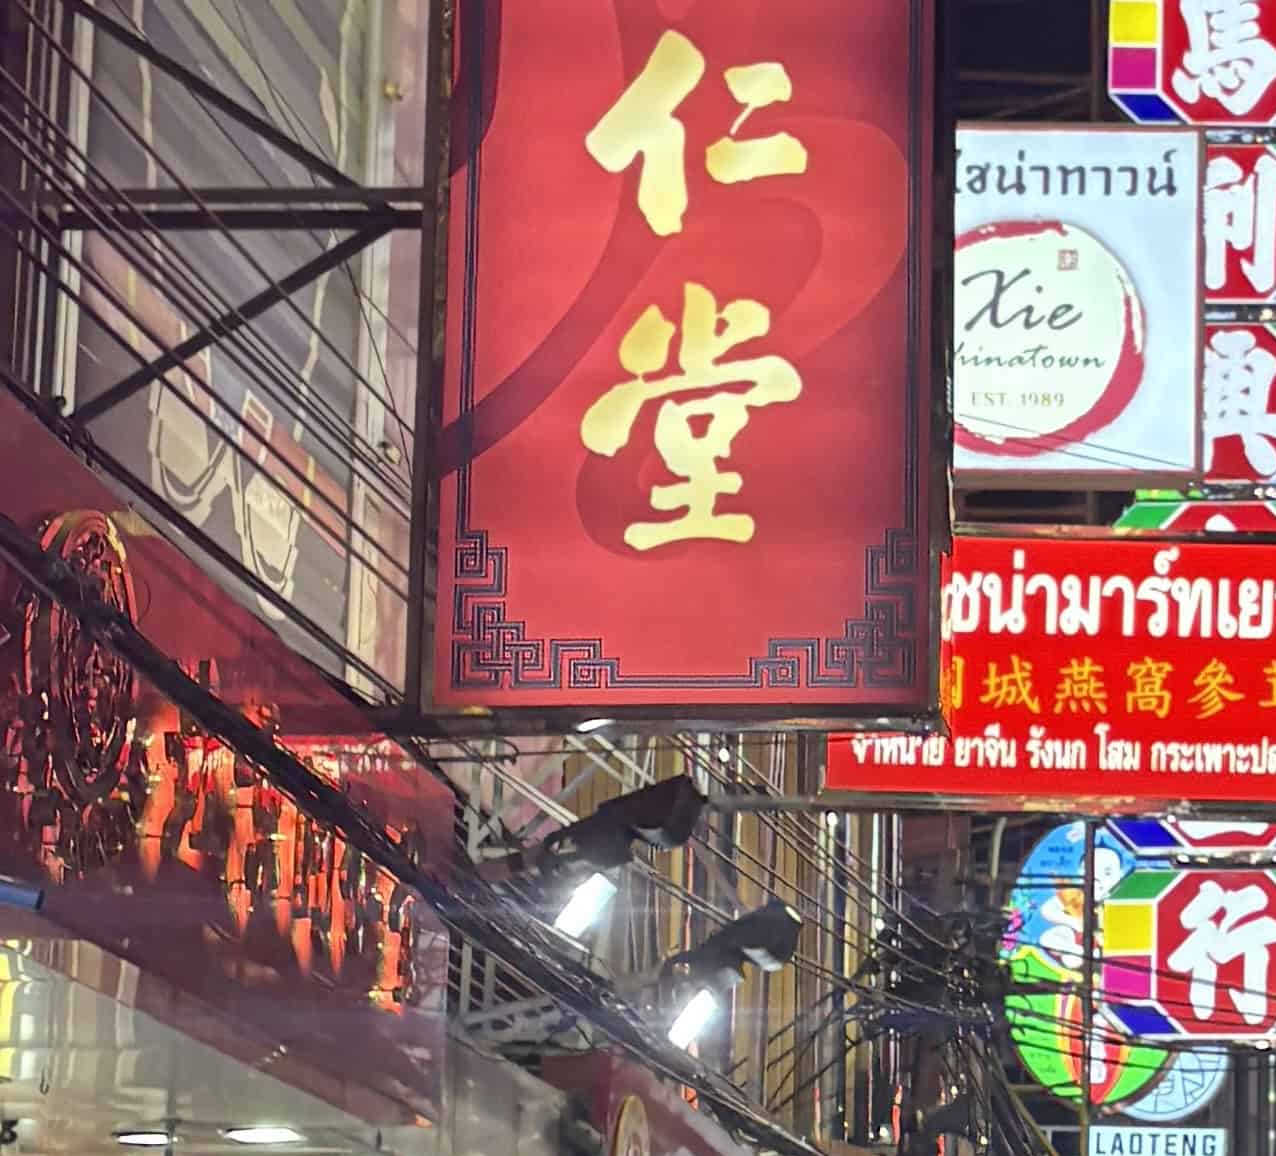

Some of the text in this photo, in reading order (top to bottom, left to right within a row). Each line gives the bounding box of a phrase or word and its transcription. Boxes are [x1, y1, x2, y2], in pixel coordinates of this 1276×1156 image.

[580, 29, 808, 550] 仁堂
[961, 268, 1083, 333] Xie
[954, 341, 1106, 368] hinatown
[1020, 391, 1065, 408] 1989
[954, 721, 1017, 769] ยาจีน
[1026, 724, 1087, 771] รังนก
